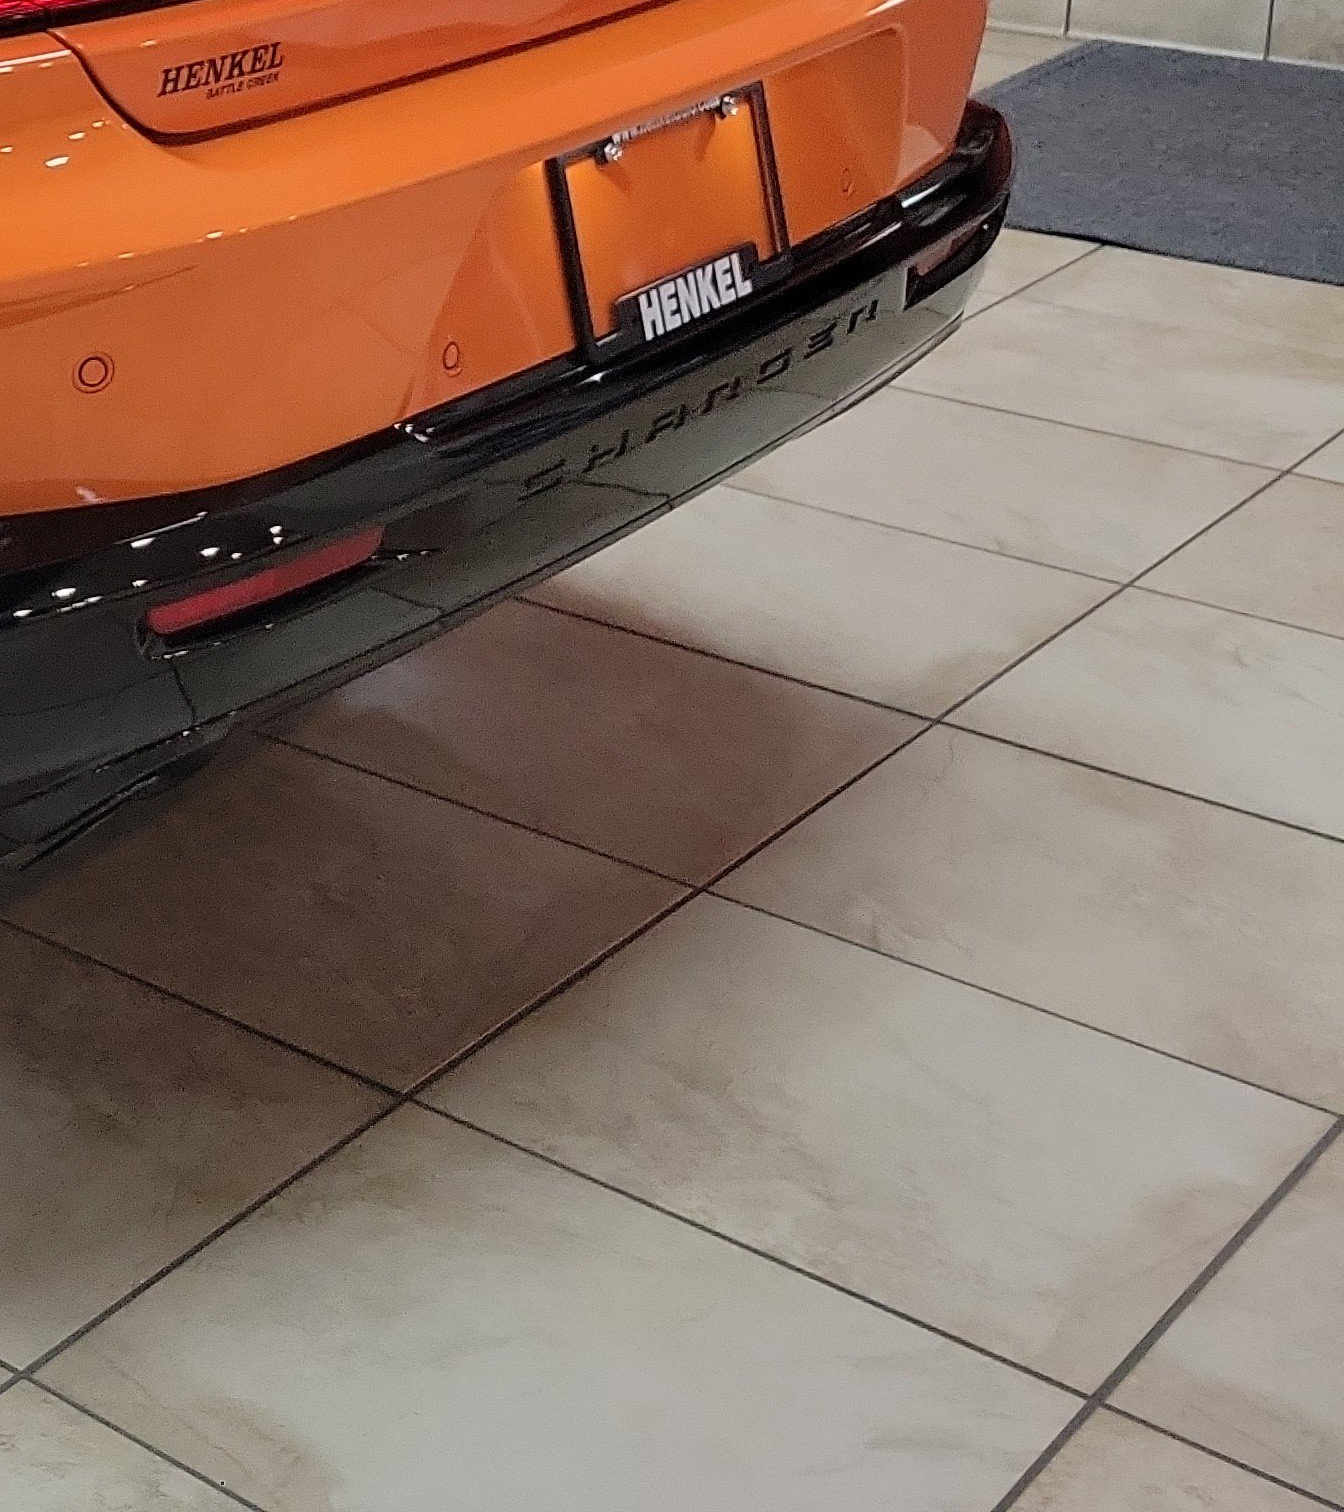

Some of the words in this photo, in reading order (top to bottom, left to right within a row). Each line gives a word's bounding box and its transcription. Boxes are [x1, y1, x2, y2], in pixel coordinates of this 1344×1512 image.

[156, 41, 285, 98] HENKEL
[637, 252, 754, 341] HENKEL
[516, 298, 879, 502] CHARGER
